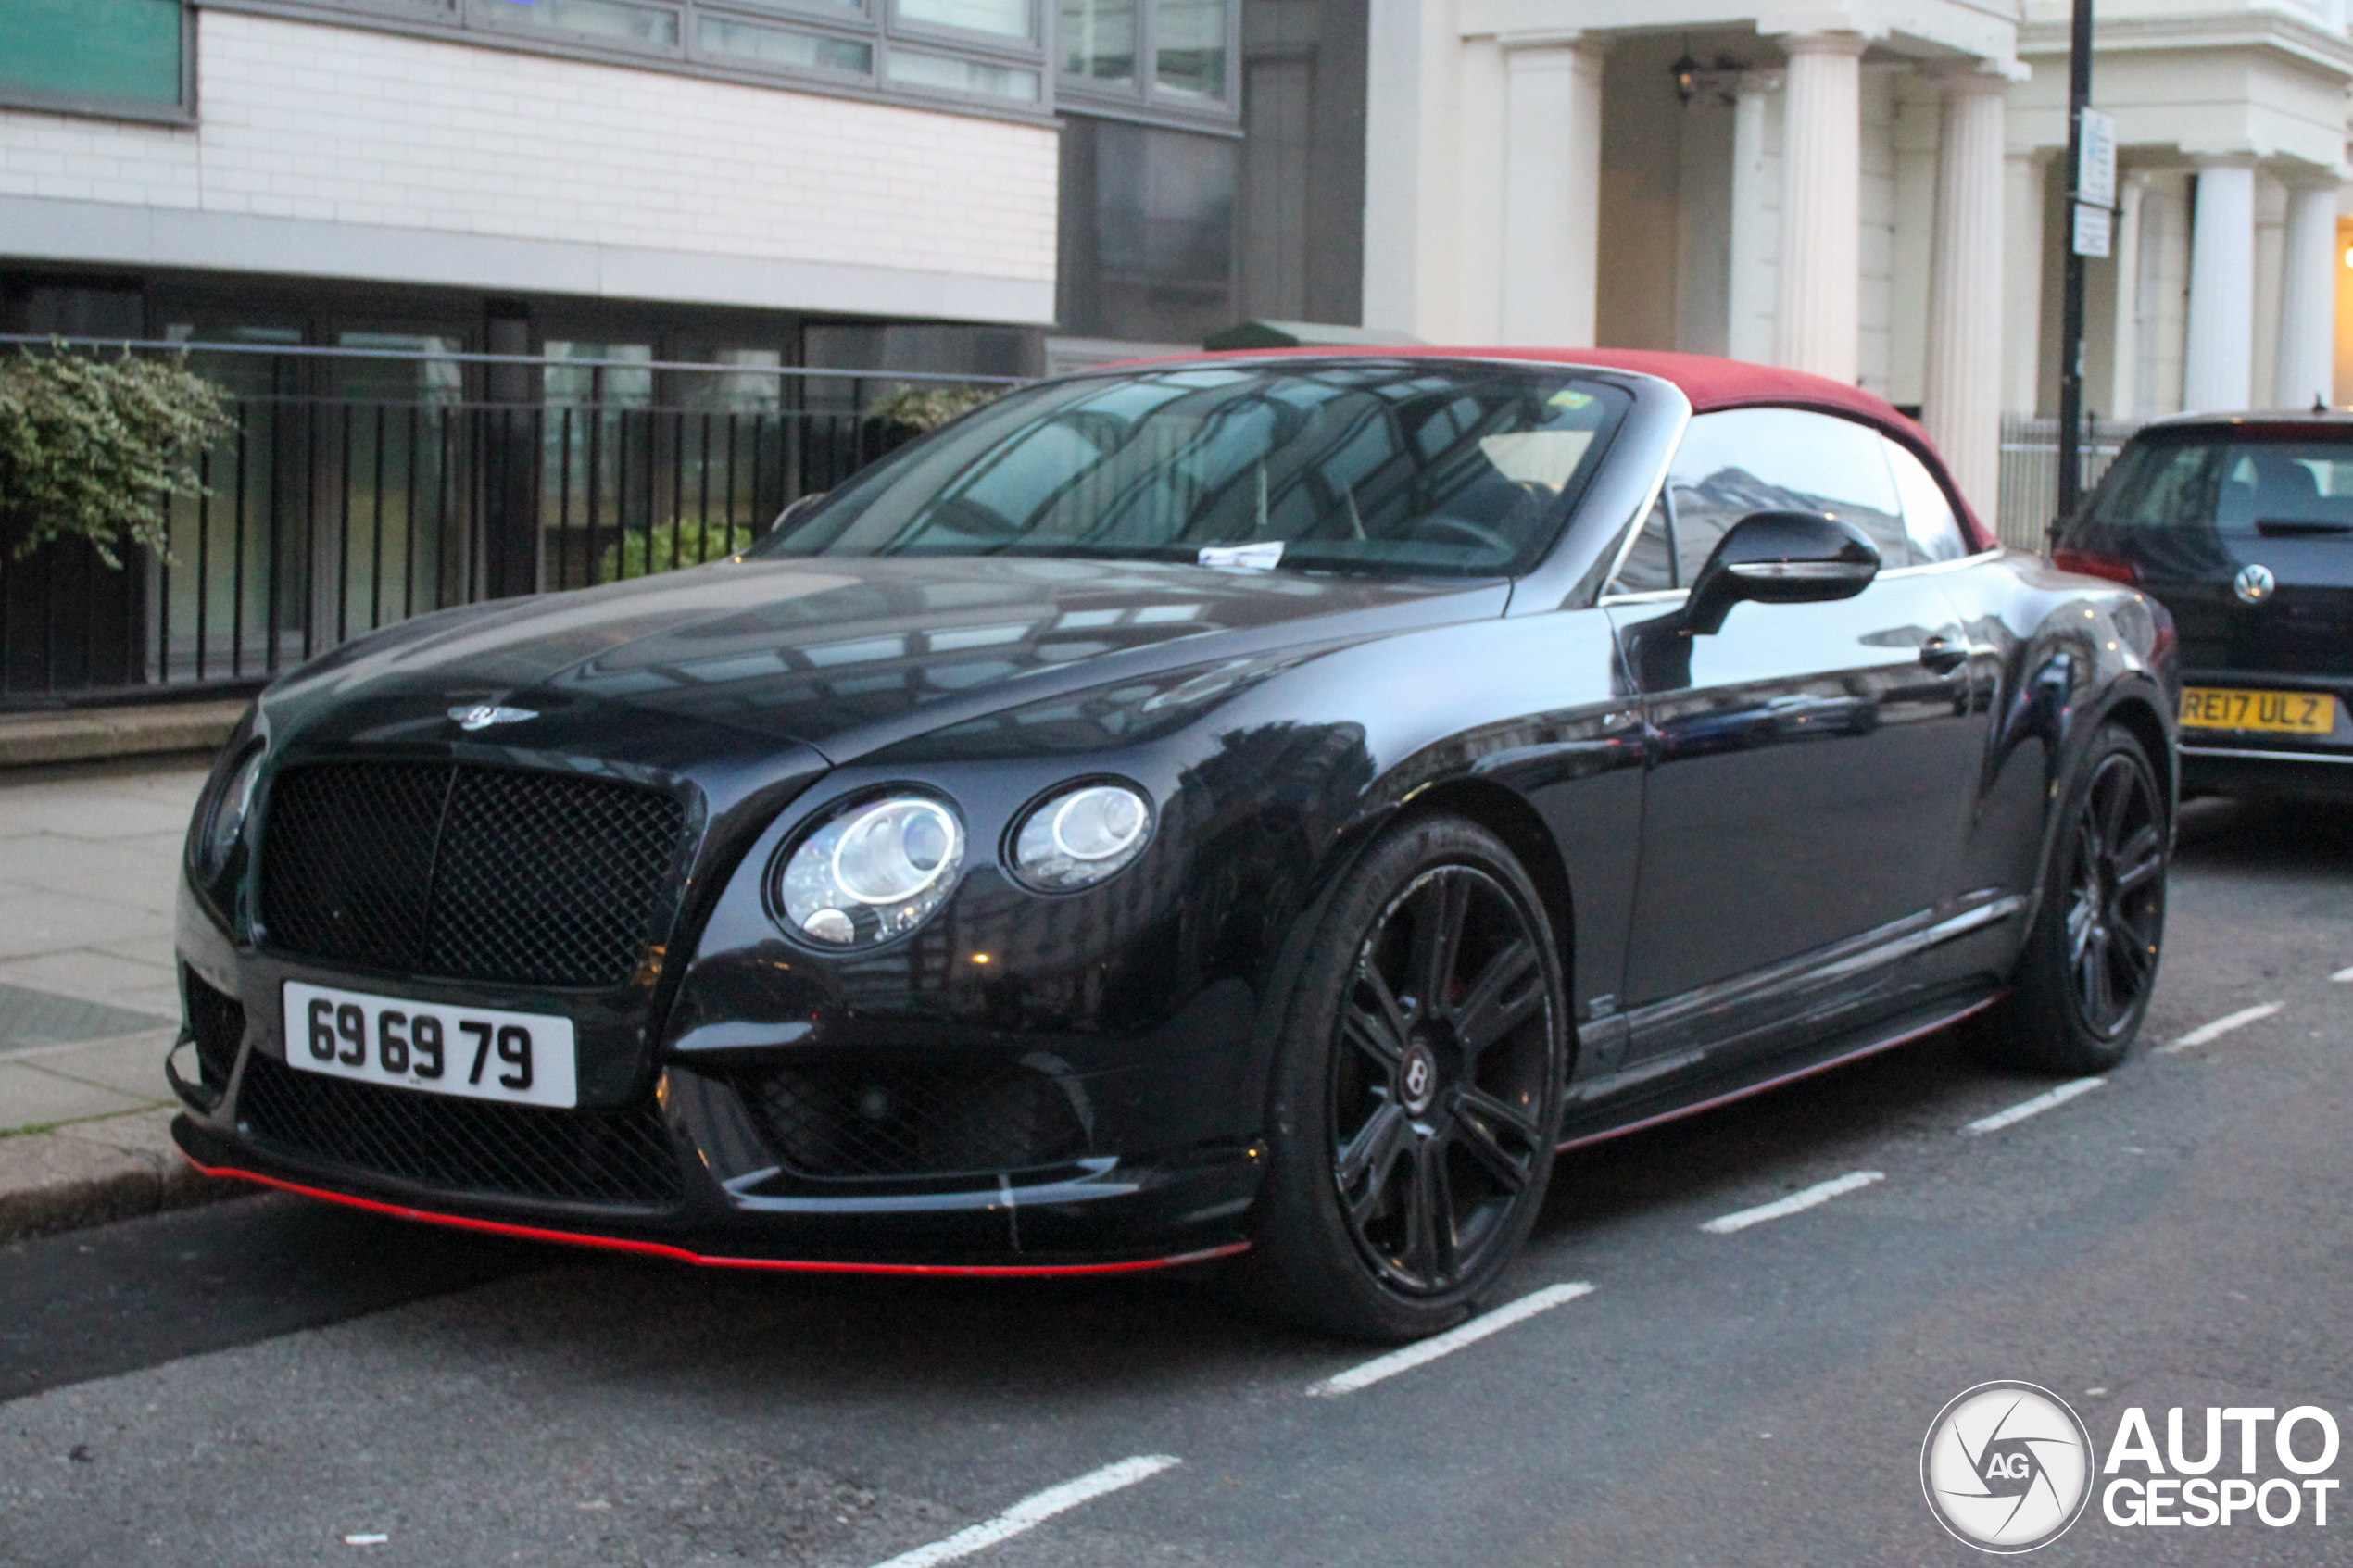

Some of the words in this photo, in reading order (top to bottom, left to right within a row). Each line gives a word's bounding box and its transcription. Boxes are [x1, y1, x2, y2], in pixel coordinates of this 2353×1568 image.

[2183, 693, 2250, 722] RE17
[2259, 694, 2319, 725] ULZ
[308, 998, 365, 1067] 69
[378, 1010, 444, 1080] 69
[459, 1020, 534, 1090] 79
